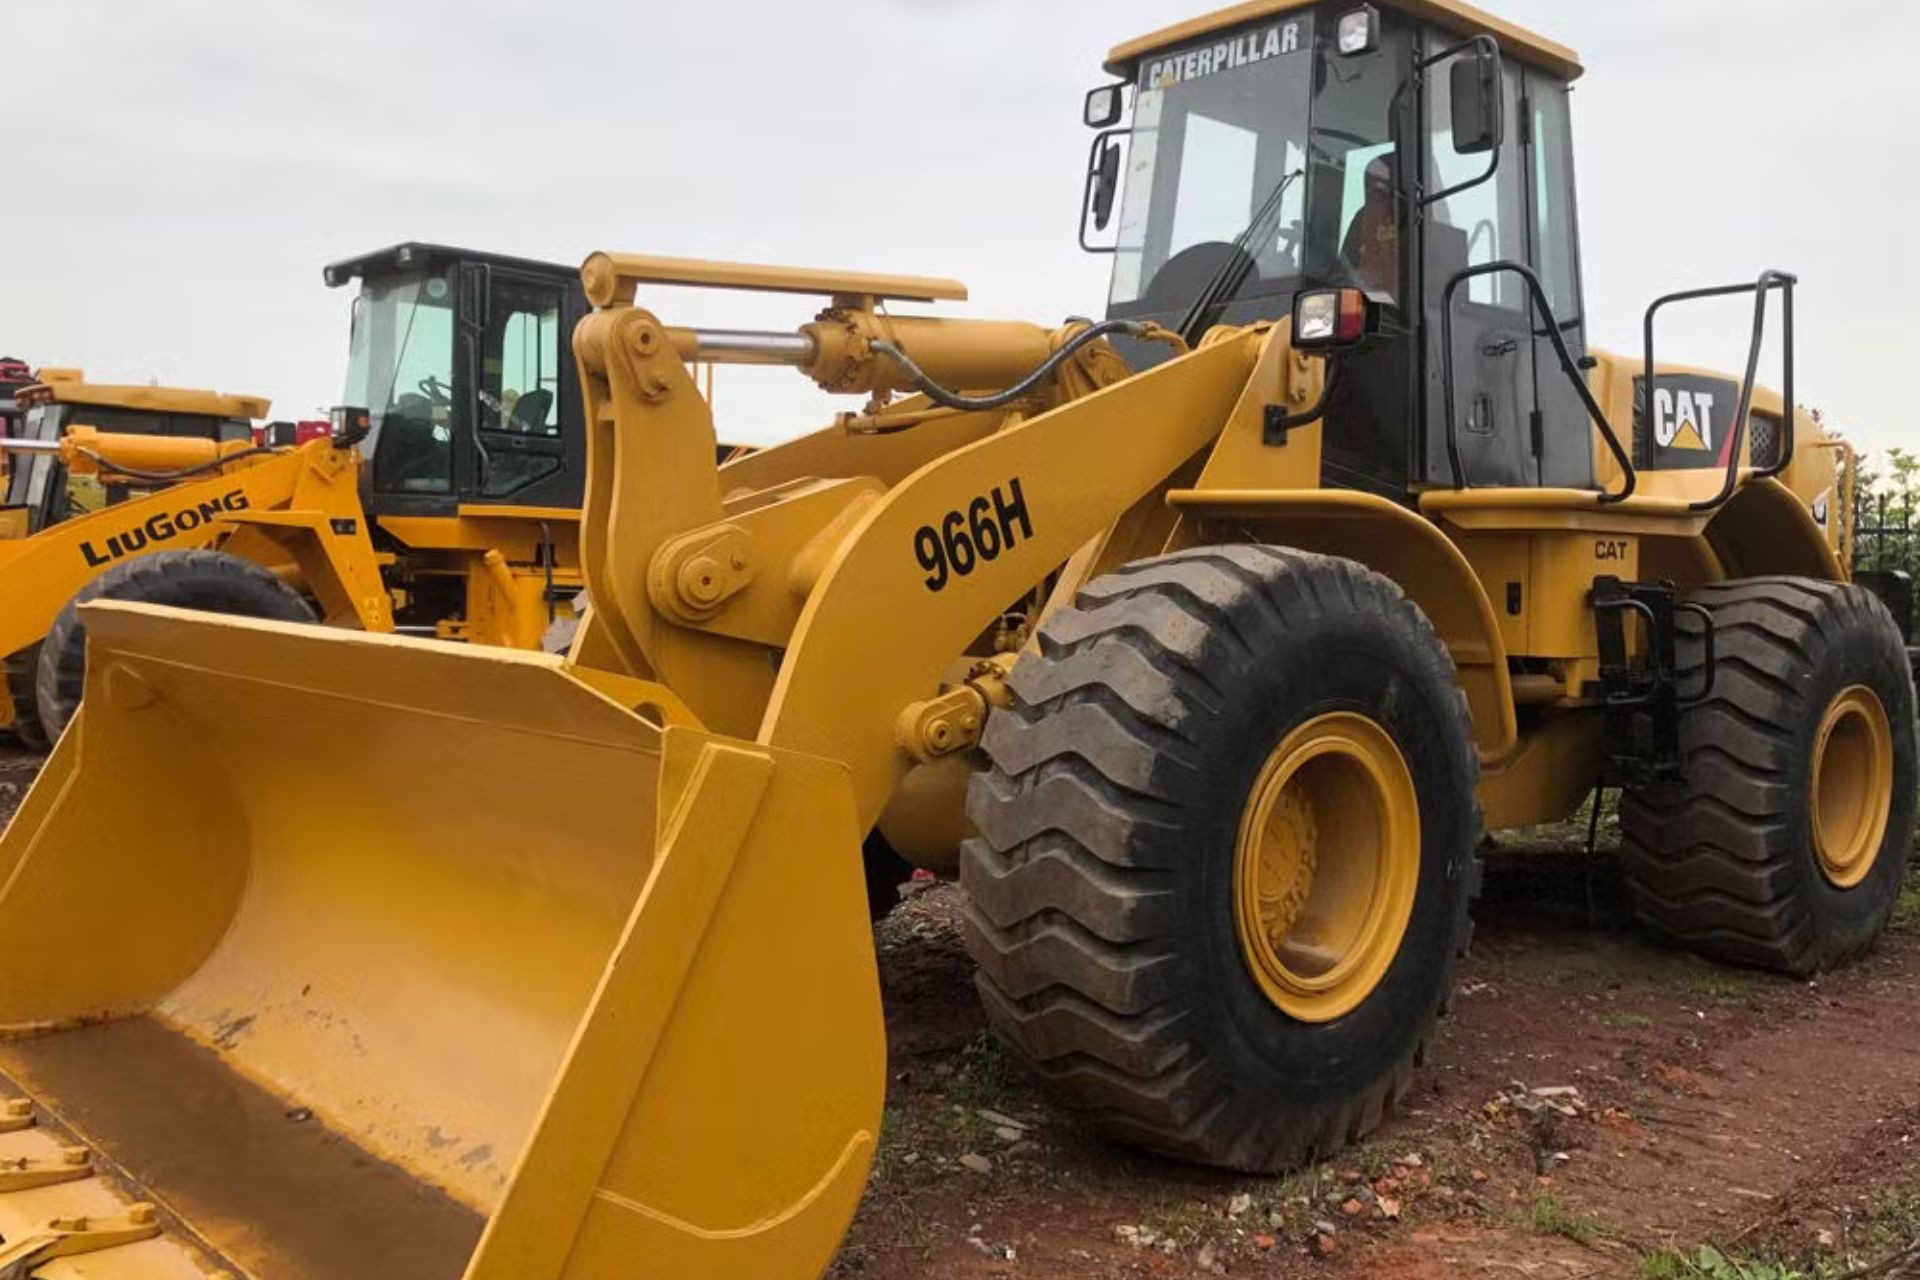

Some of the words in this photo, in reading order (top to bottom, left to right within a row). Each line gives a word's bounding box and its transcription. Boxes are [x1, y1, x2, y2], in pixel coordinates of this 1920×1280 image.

[1149, 23, 1298, 88] CATERPILLAR
[1653, 388, 1713, 451] CAT
[79, 489, 249, 568] LIUGONG
[914, 477, 1033, 592] 966H
[1595, 541, 1627, 560] CAT
